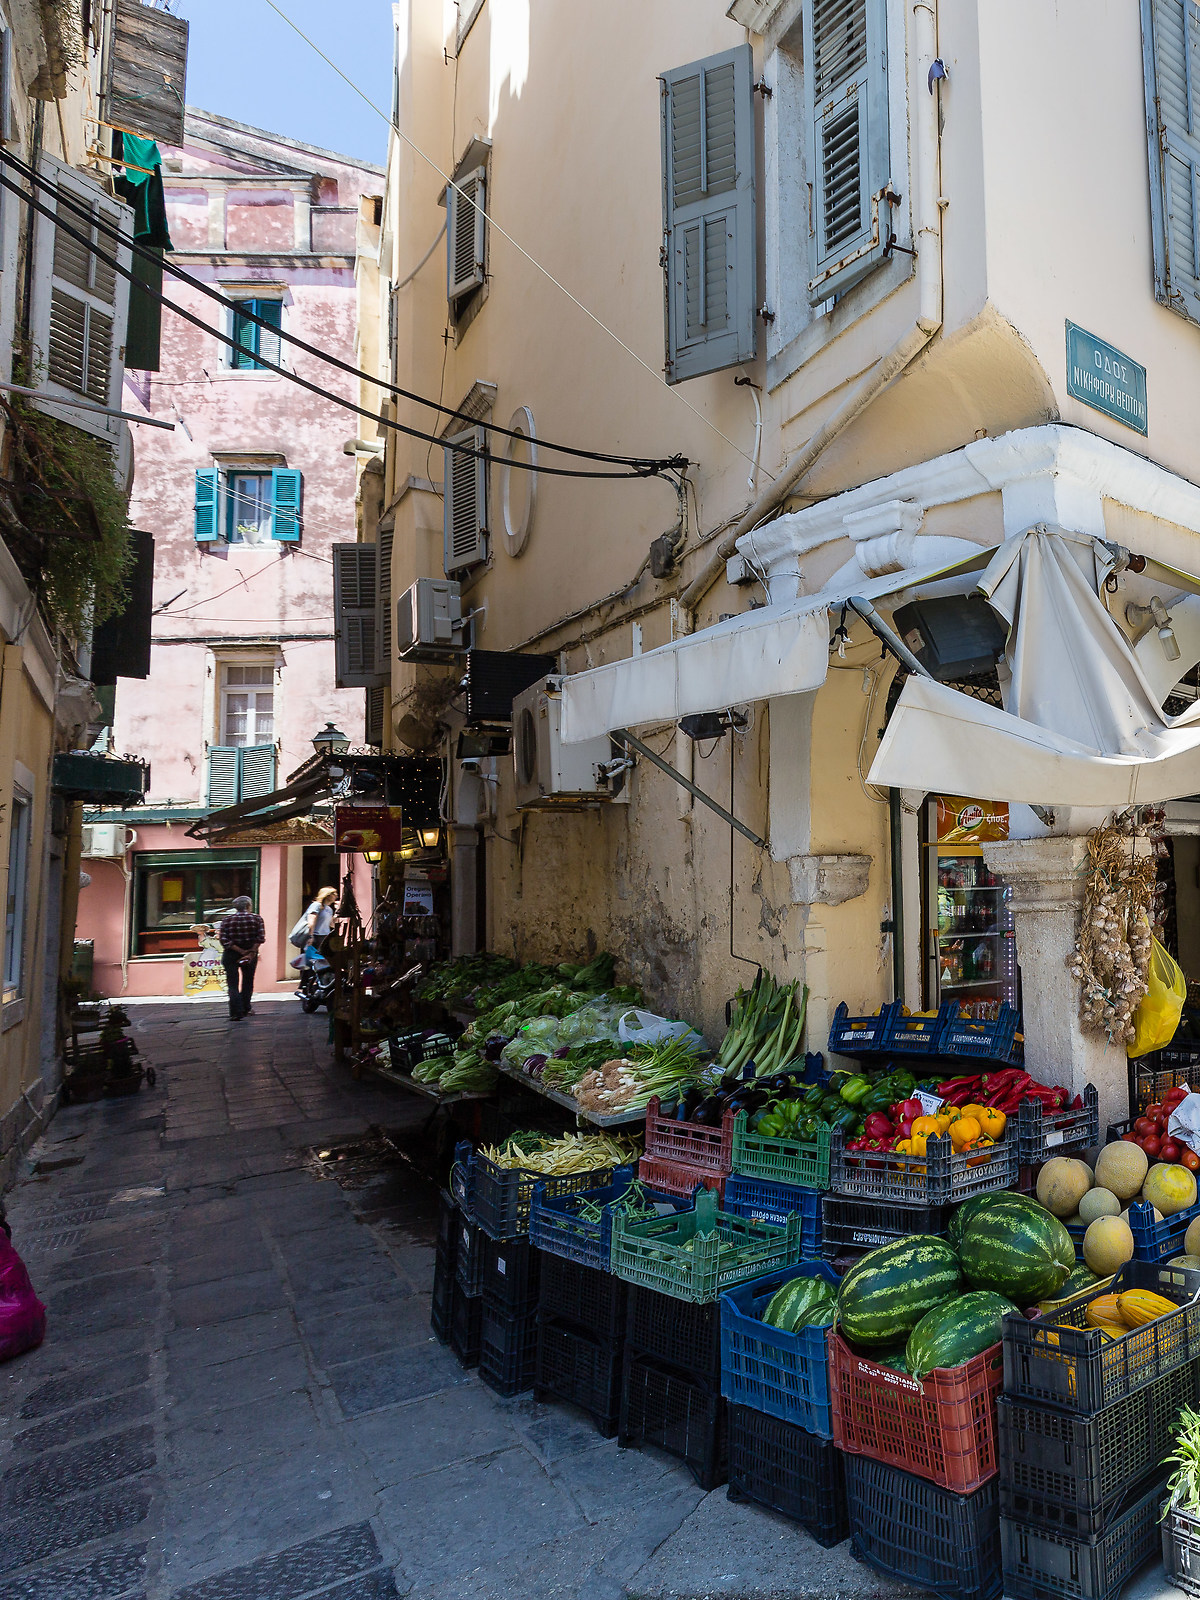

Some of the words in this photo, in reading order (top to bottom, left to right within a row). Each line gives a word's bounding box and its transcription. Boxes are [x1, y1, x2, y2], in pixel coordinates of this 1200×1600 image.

[1094, 350, 1128, 384] ΟΔΟΣ
[961, 807, 983, 825] Amita
[952, 1164, 1006, 1184] ΦΡΑΓΚΟΥΛΗΣ
